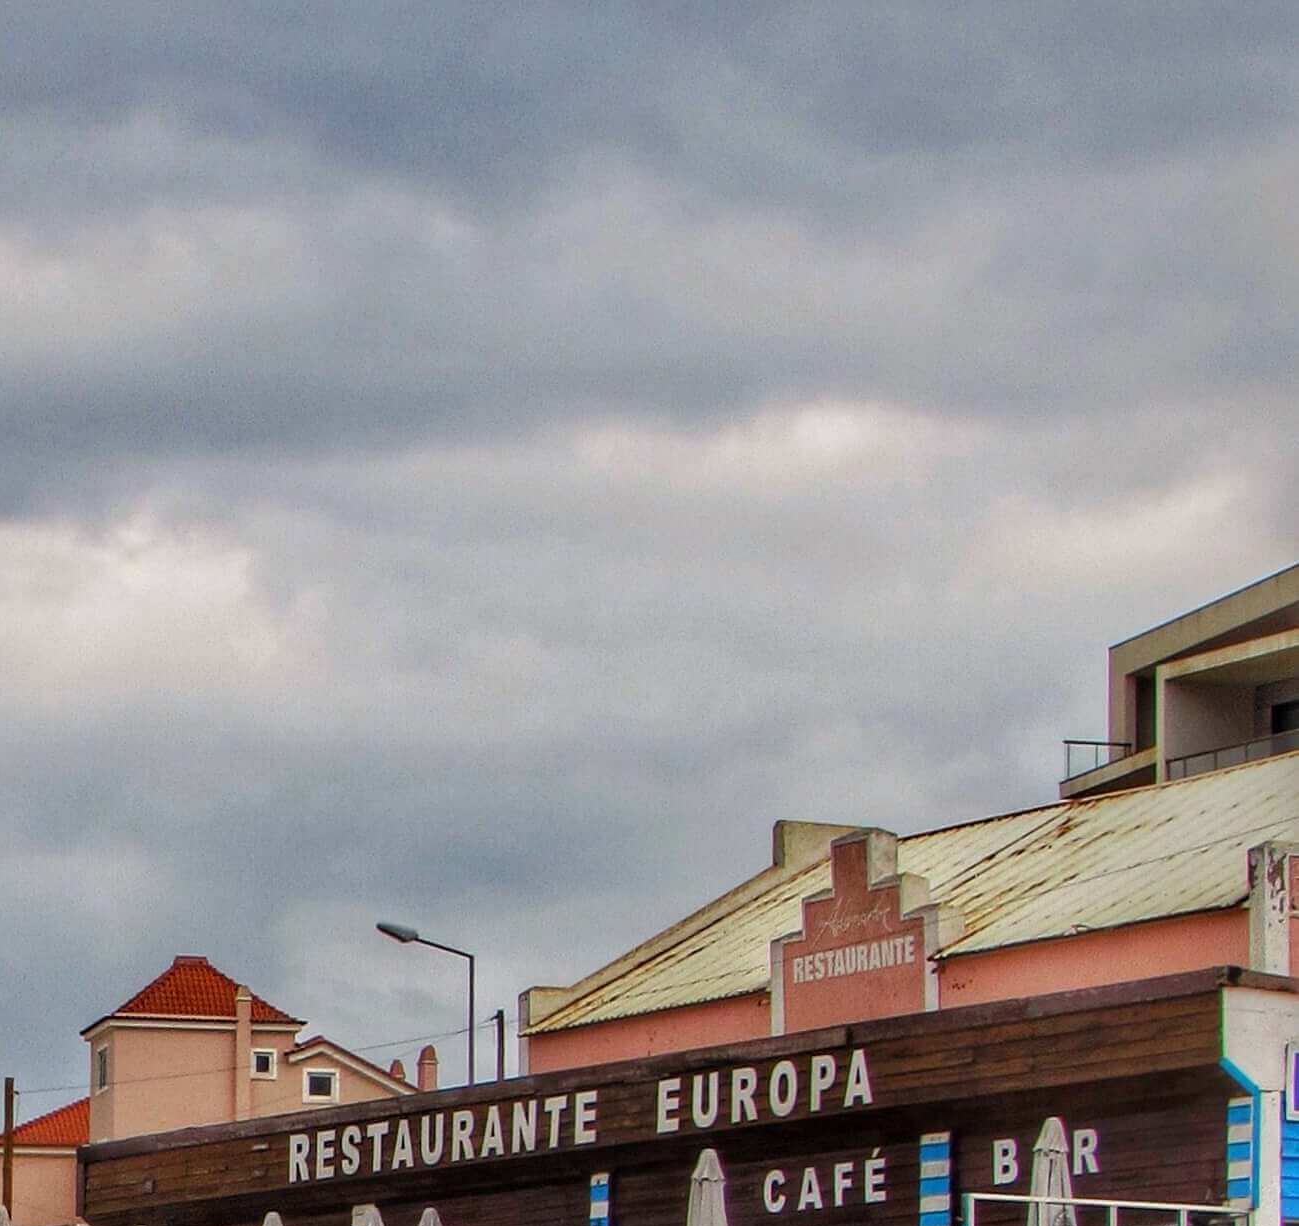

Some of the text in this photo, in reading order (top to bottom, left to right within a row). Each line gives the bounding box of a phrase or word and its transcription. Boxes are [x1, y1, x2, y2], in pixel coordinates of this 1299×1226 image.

[793, 937, 914, 984] RESTAURANTE
[289, 1049, 872, 1183] RESTAURANTE EUROPA
[764, 1149, 887, 1213] CAFÉ
[993, 1129, 1099, 1185] BR
